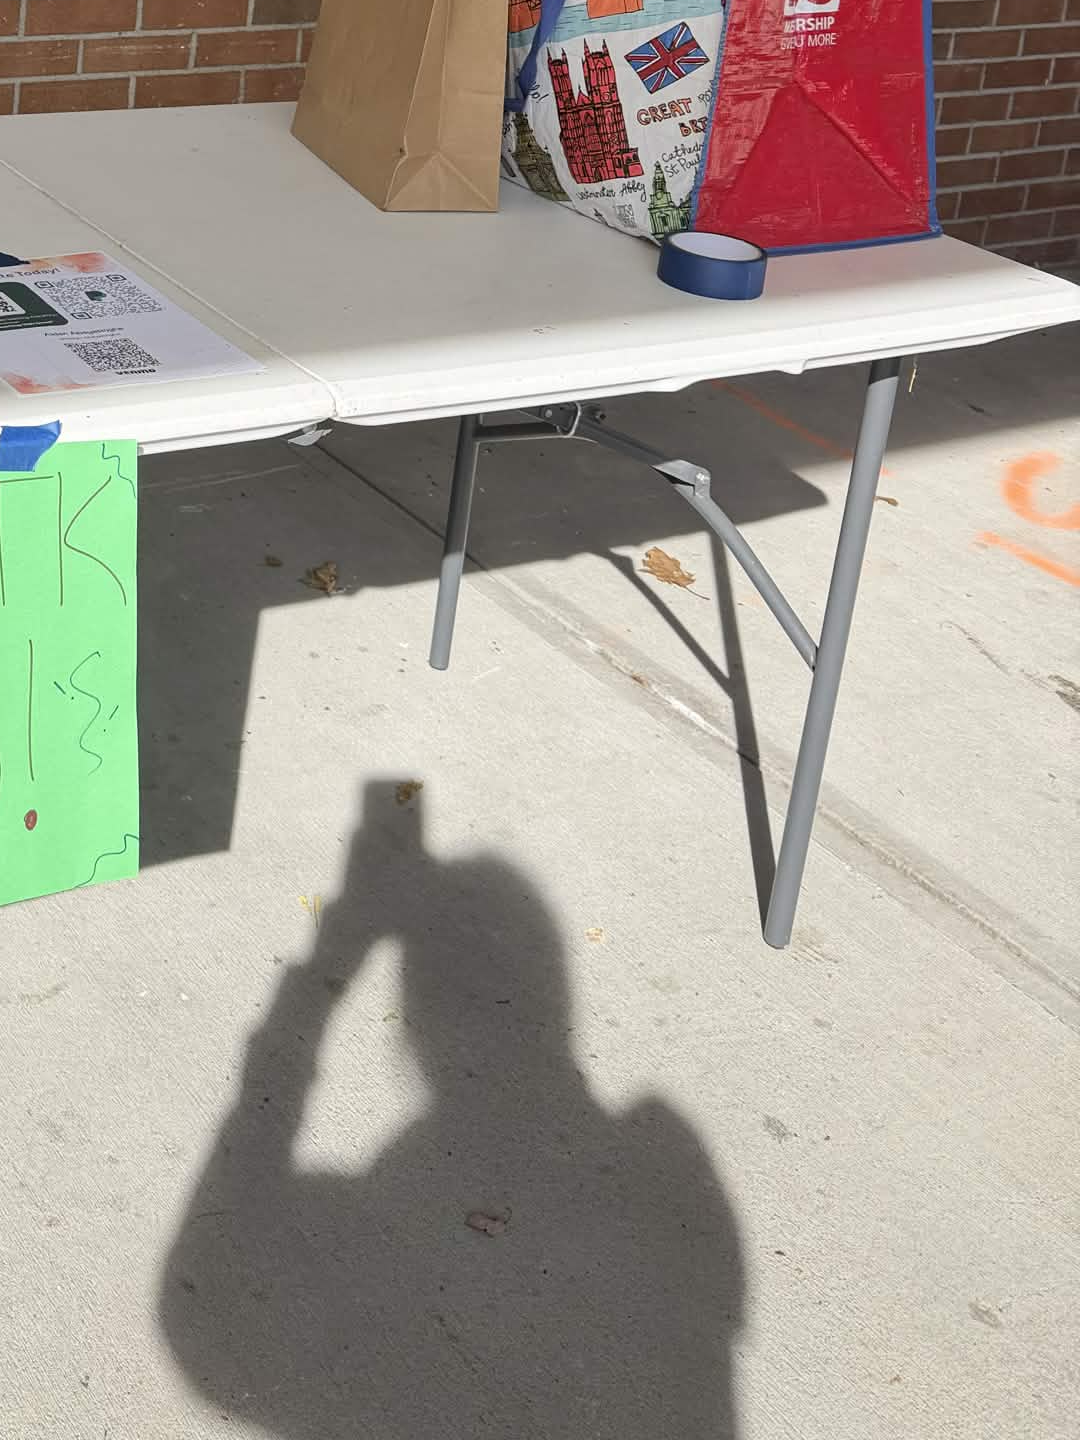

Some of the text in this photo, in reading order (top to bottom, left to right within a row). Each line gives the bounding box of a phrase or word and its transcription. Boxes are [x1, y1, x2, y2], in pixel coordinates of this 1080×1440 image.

[807, 32, 837, 47] MORE
[636, 97, 693, 126] GREAT
[15, 266, 62, 278] Today!
